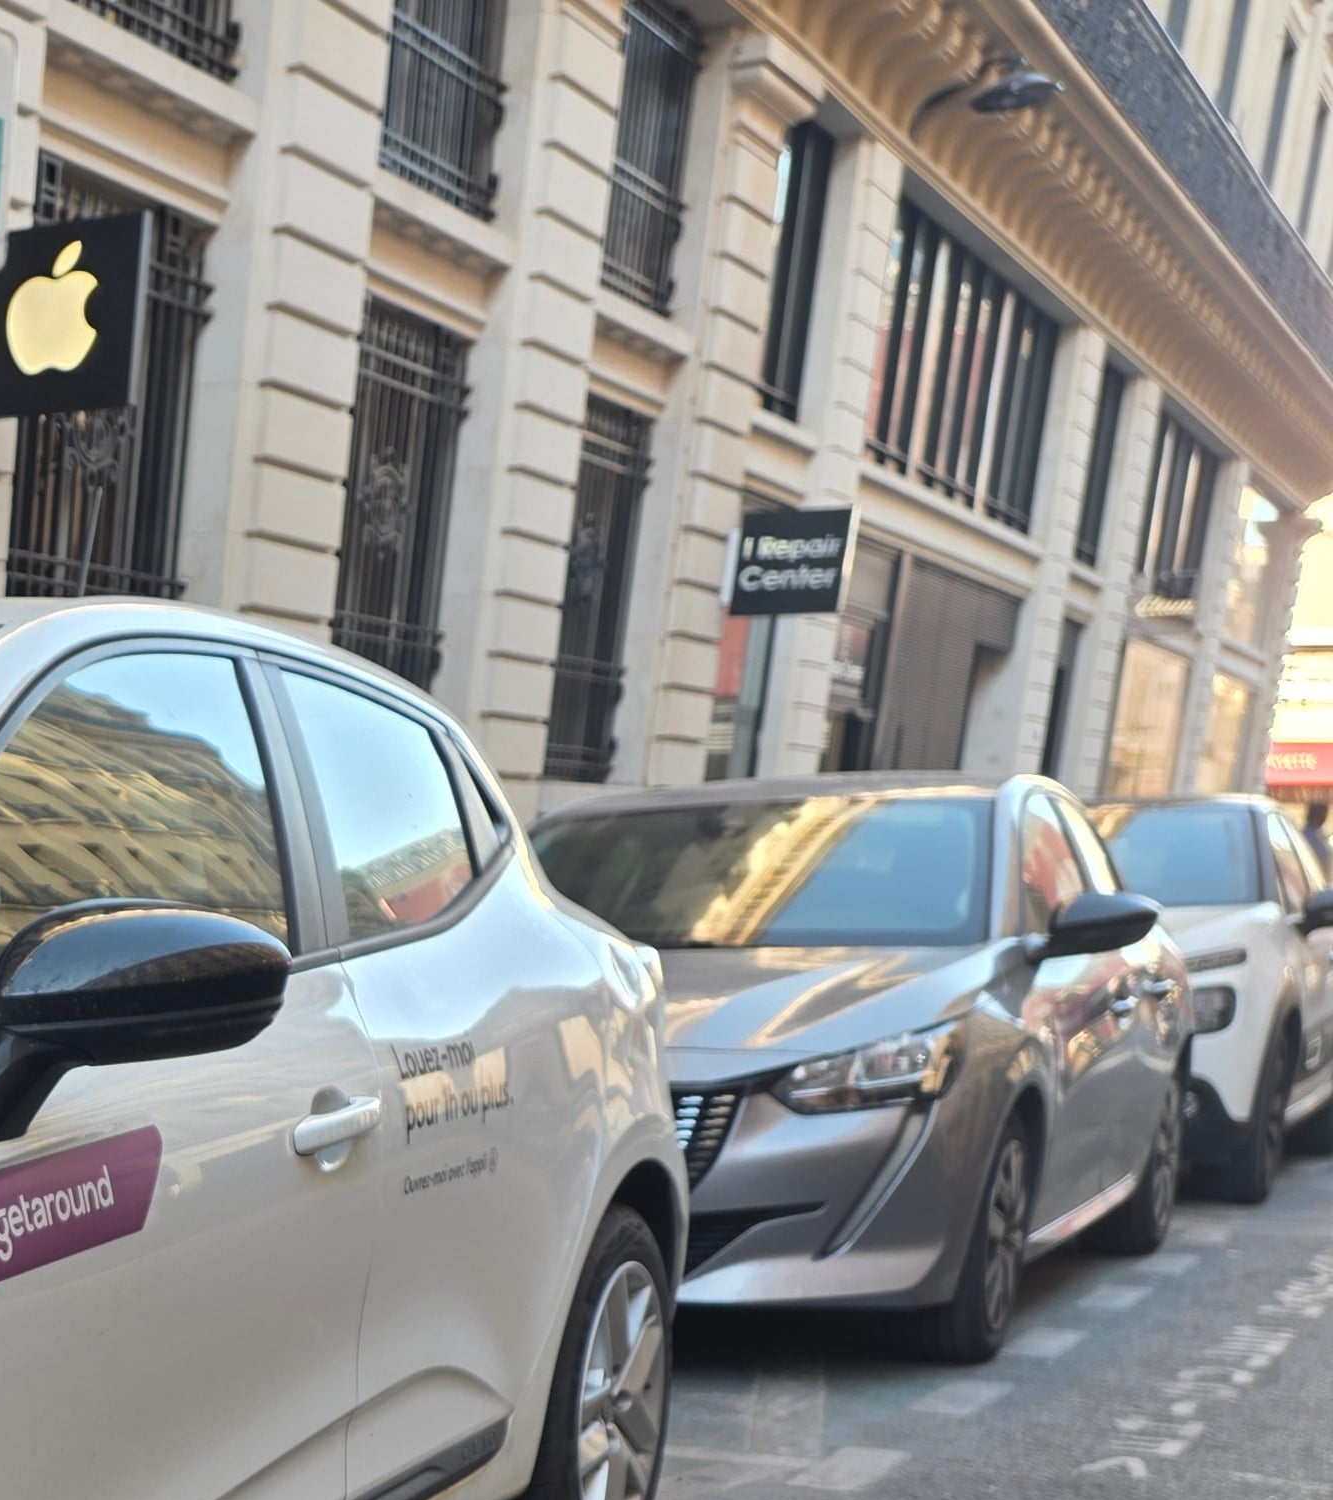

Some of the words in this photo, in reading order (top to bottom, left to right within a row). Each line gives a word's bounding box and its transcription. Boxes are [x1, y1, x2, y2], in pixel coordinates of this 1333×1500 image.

[756, 533, 843, 563] Repair
[738, 563, 839, 592] Center
[391, 1041, 476, 1079] Louez-moi
[405, 1098, 439, 1144] pour
[444, 1086, 459, 1124] 1h
[462, 1089, 479, 1117] ou
[481, 1080, 515, 1123] plus.
